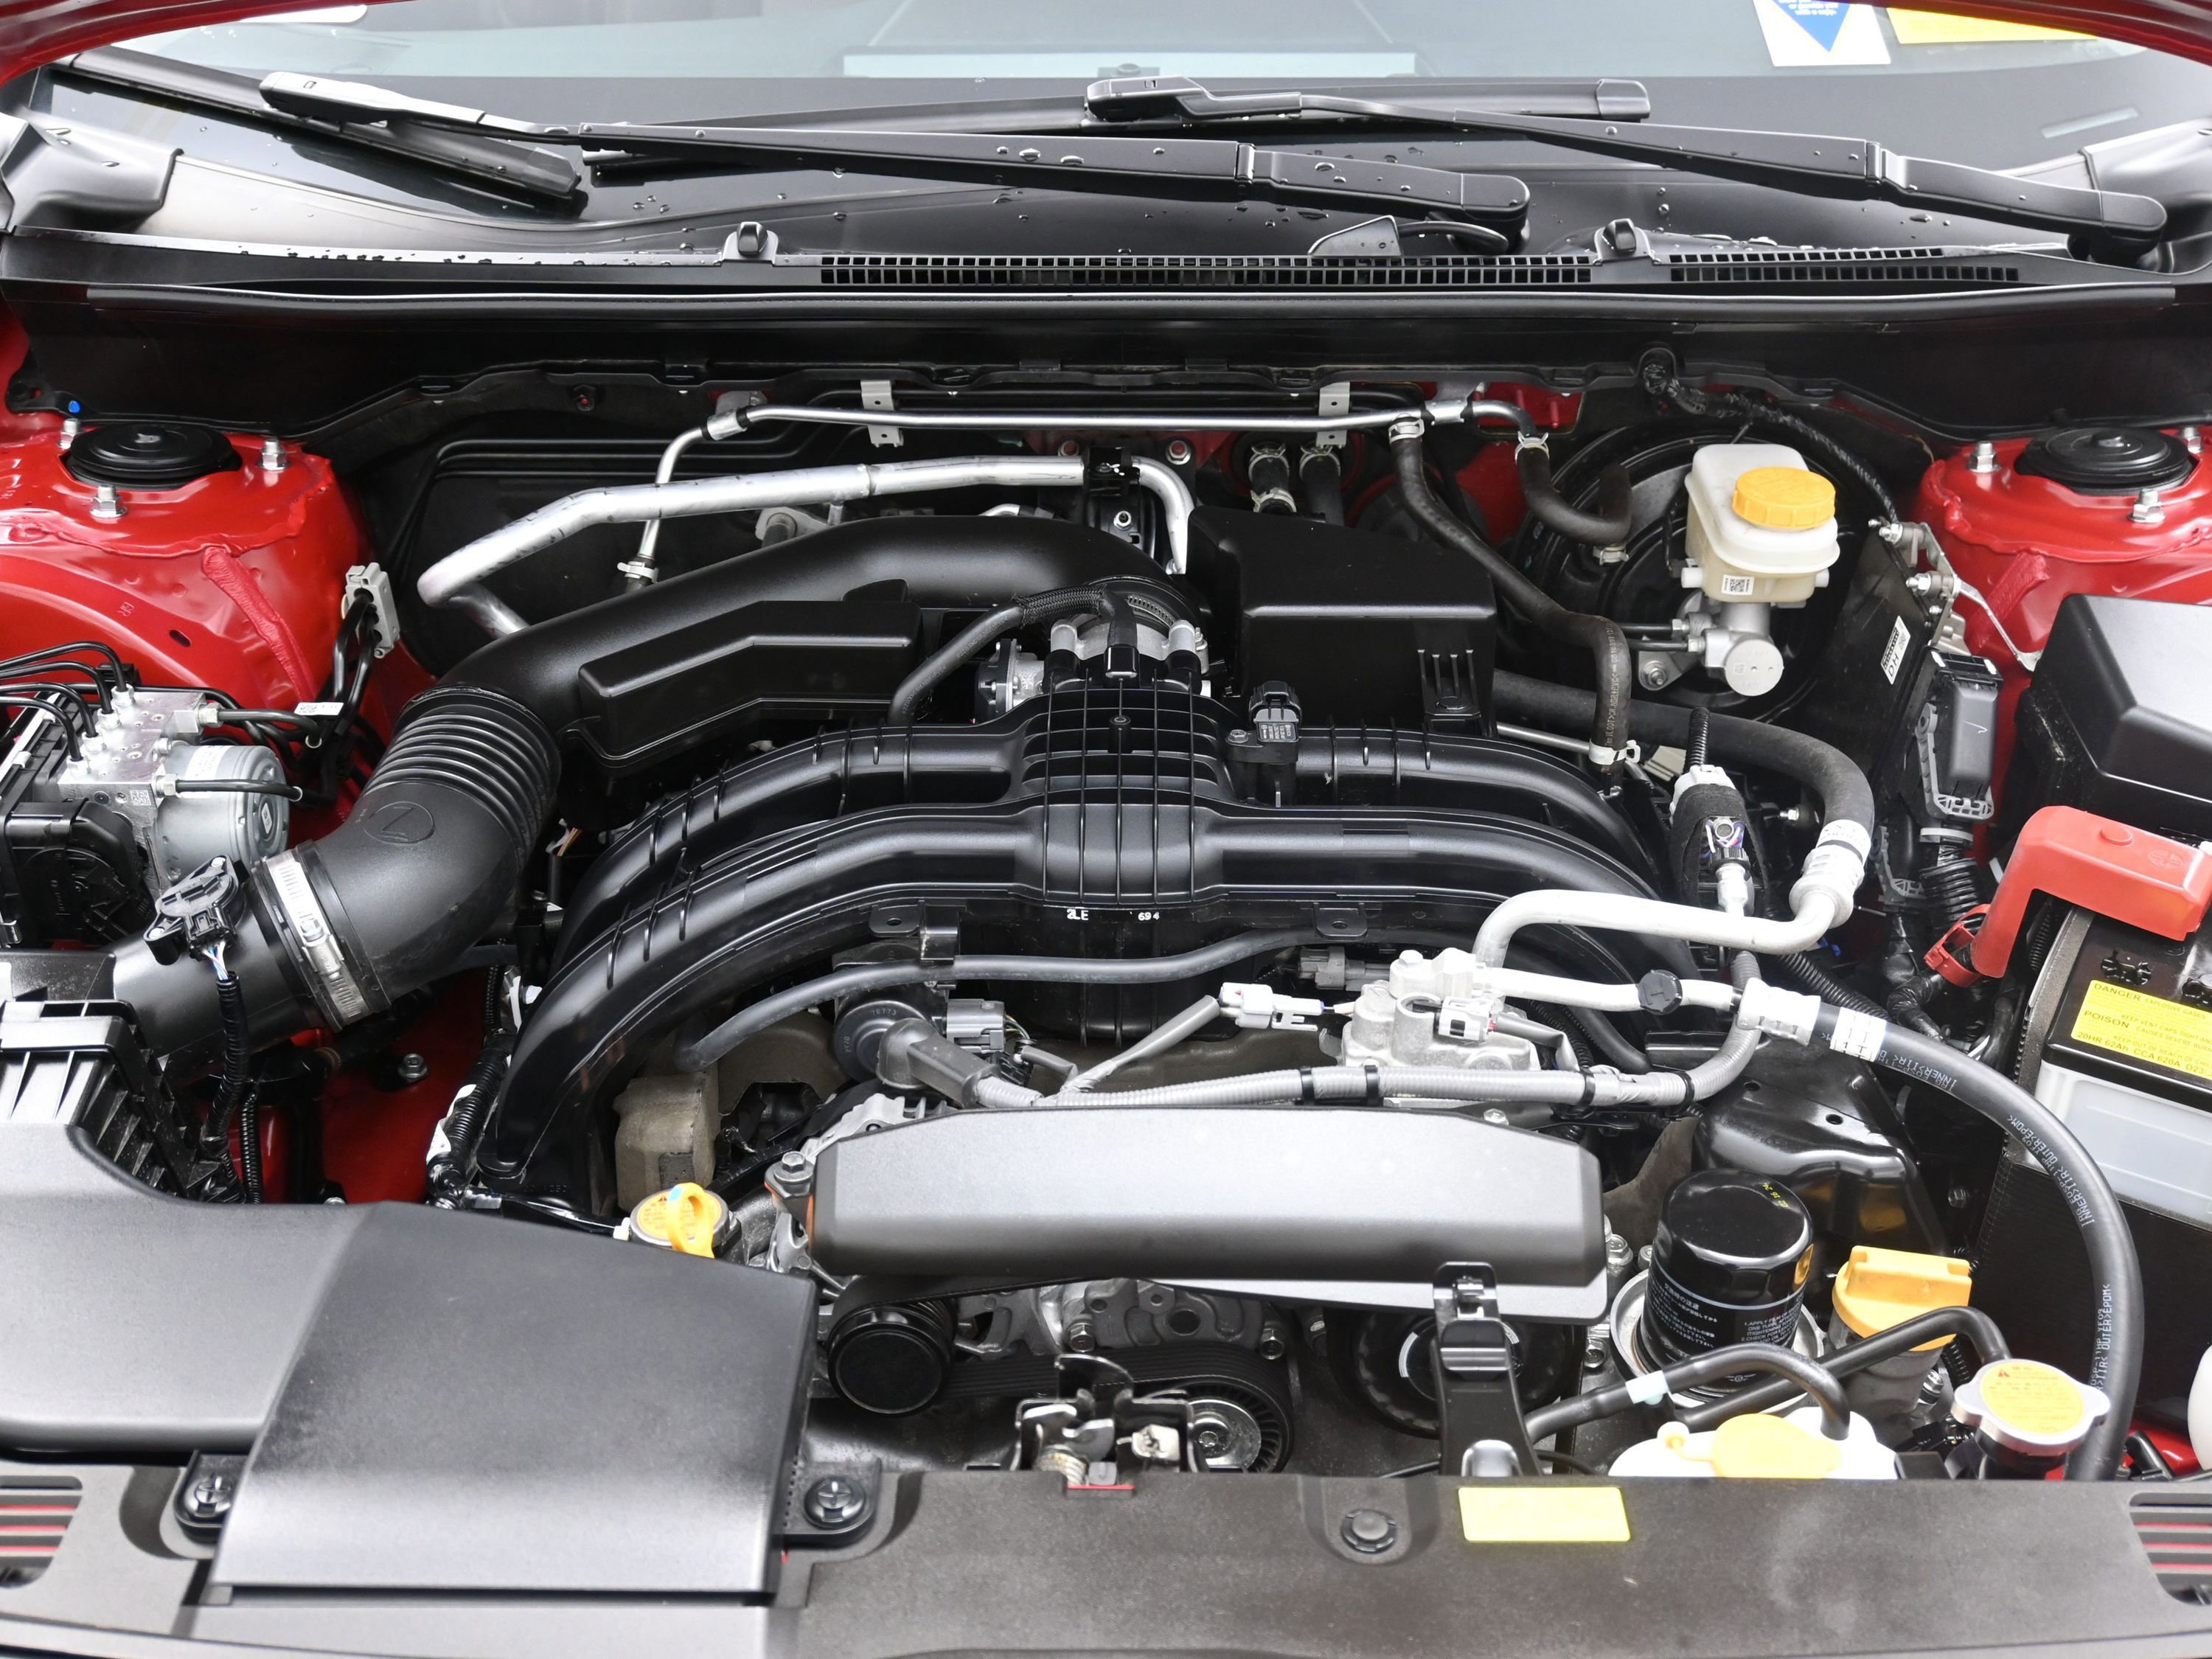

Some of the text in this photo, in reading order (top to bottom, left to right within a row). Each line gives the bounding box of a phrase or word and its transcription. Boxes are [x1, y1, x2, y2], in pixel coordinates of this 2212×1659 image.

[1138, 911, 1160, 921] 694
[2094, 983, 2141, 1001] DANGER
[2145, 998, 2180, 1013] EXPLOSIVE
[2183, 1009, 2206, 1019] GASES
[2084, 1010, 2130, 1029] POISON
[2136, 1026, 2163, 1038] CAUSES
[2140, 1019, 2157, 1028] VENT
[2160, 1025, 2177, 1034] CAPS
[2077, 1032, 2103, 1044] 20HR
[2104, 1040, 2129, 1052] 62Ah
[2133, 1048, 2154, 1060] CCA
[2157, 1056, 2180, 1068] 620A
[2132, 1040, 2147, 1048] OUT
